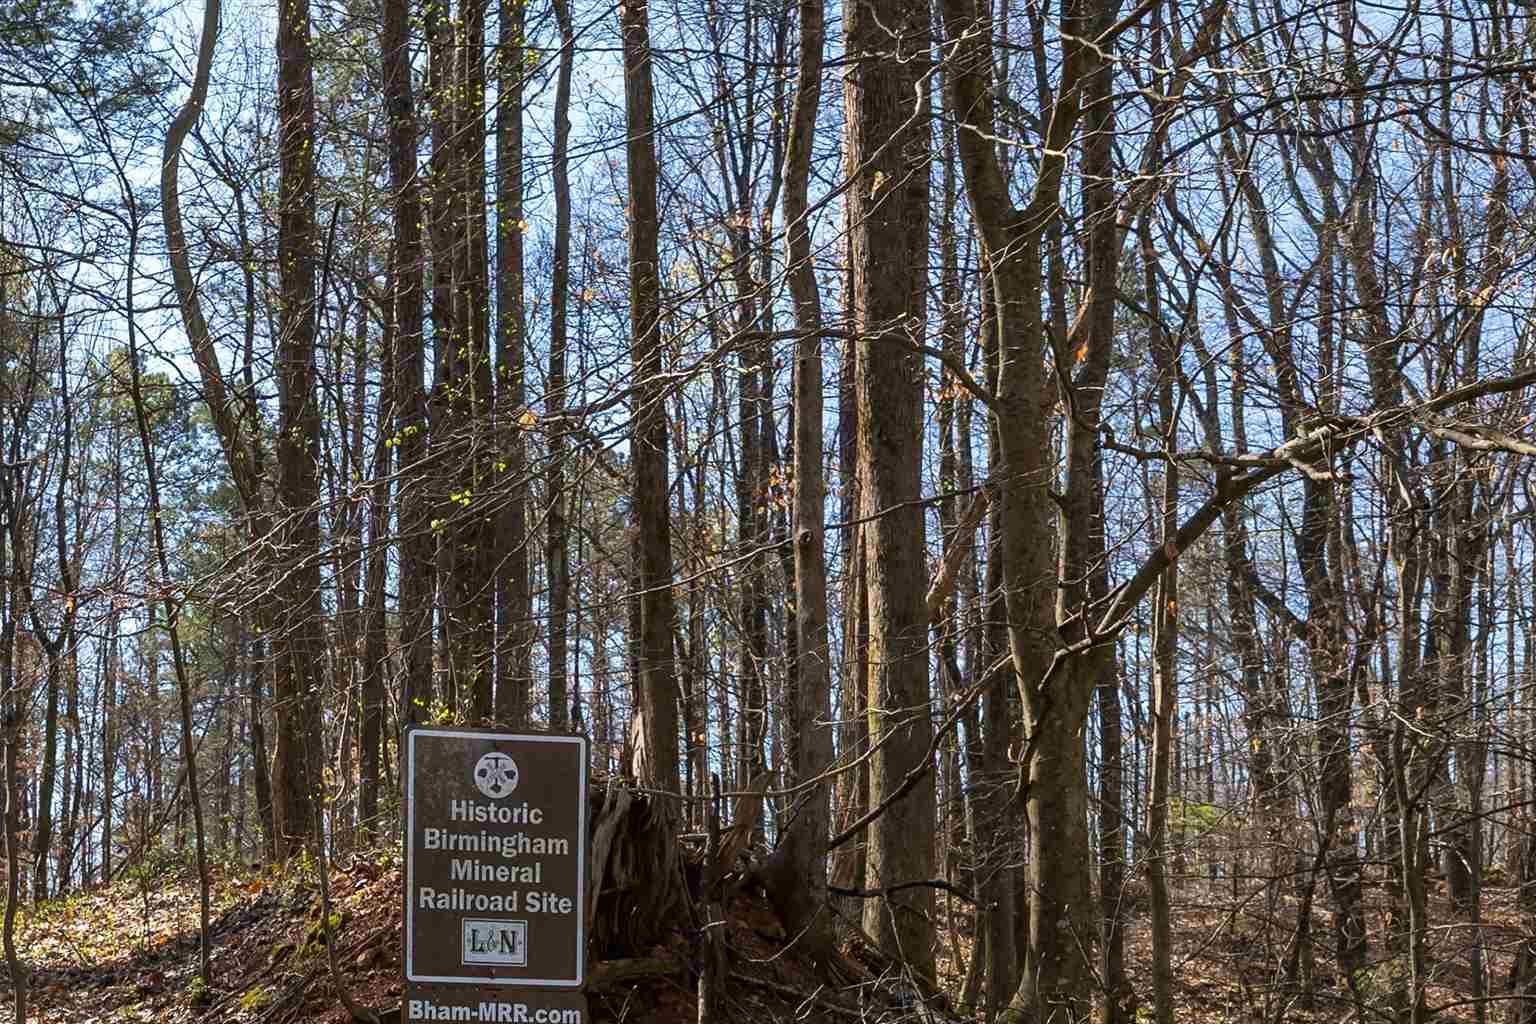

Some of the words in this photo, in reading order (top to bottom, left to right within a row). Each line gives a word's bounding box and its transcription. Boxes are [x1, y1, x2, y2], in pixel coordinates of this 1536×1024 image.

[450, 799, 543, 825] Historic
[424, 828, 569, 858] Birmingham
[450, 859, 542, 883] Mineral
[419, 887, 518, 913] Railroad
[525, 891, 573, 914] Site
[408, 1000, 582, 1024] Bham-MRR.com
